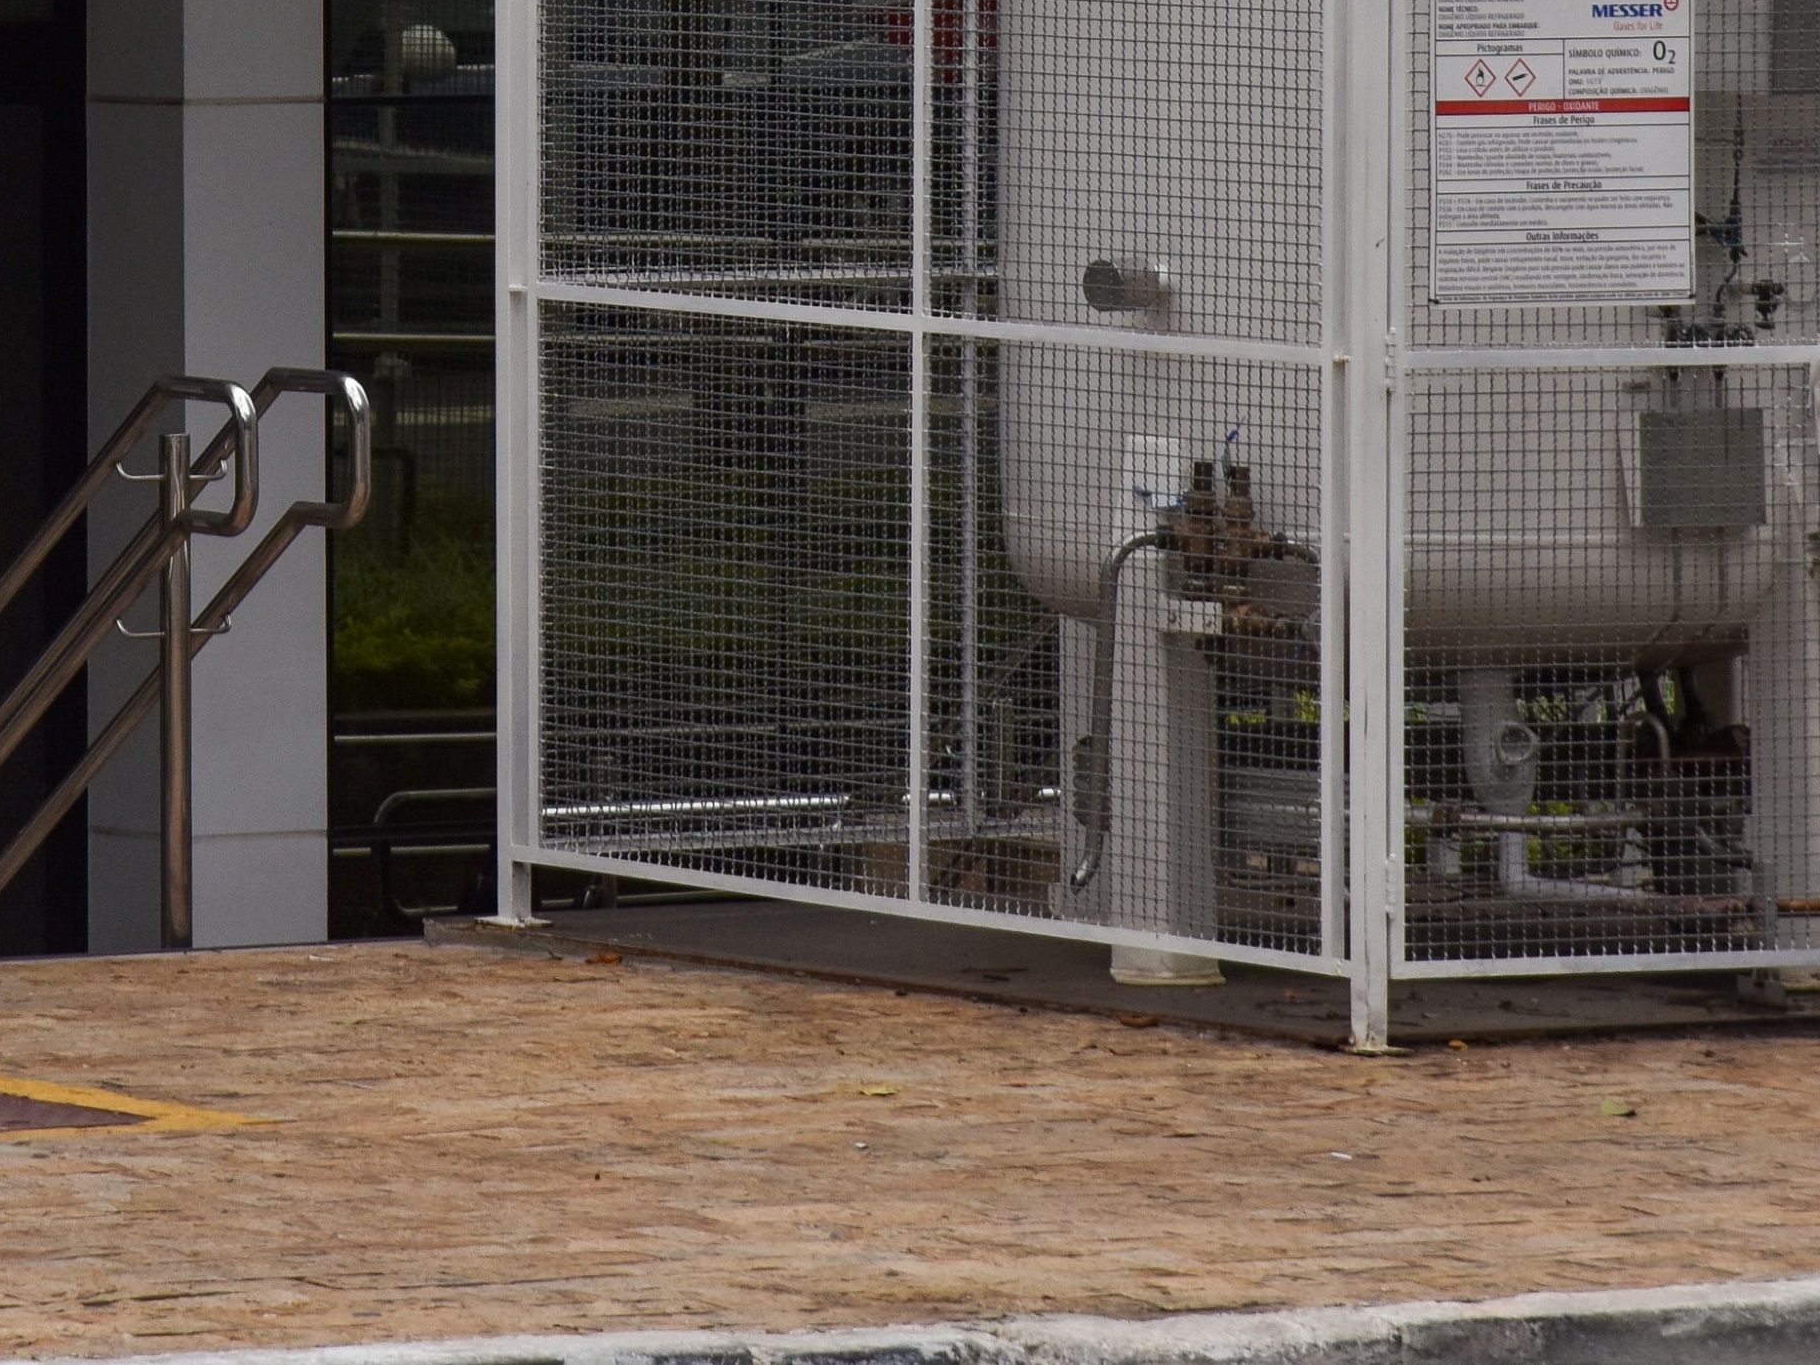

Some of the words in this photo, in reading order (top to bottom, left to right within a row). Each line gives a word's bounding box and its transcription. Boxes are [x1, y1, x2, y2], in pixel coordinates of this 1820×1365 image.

[1592, 3, 1663, 18] MESSER
[1613, 21, 1634, 31] Gases
[1636, 21, 1648, 30] for
[1649, 21, 1663, 30] Life
[1477, 42, 1523, 54] Pictogramas
[1568, 48, 1603, 58] SÍMBOLO
[1528, 102, 1555, 111] PERIGO
[1563, 100, 1600, 111] OXIDANTE
[1533, 114, 1557, 125] Frases
[1558, 114, 1569, 124] de
[1570, 114, 1595, 126] Perigo
[1526, 180, 1551, 190] Frases
[1551, 180, 1562, 190] de
[1563, 179, 1602, 192] Precaução
[1526, 231, 1550, 241] Outras
